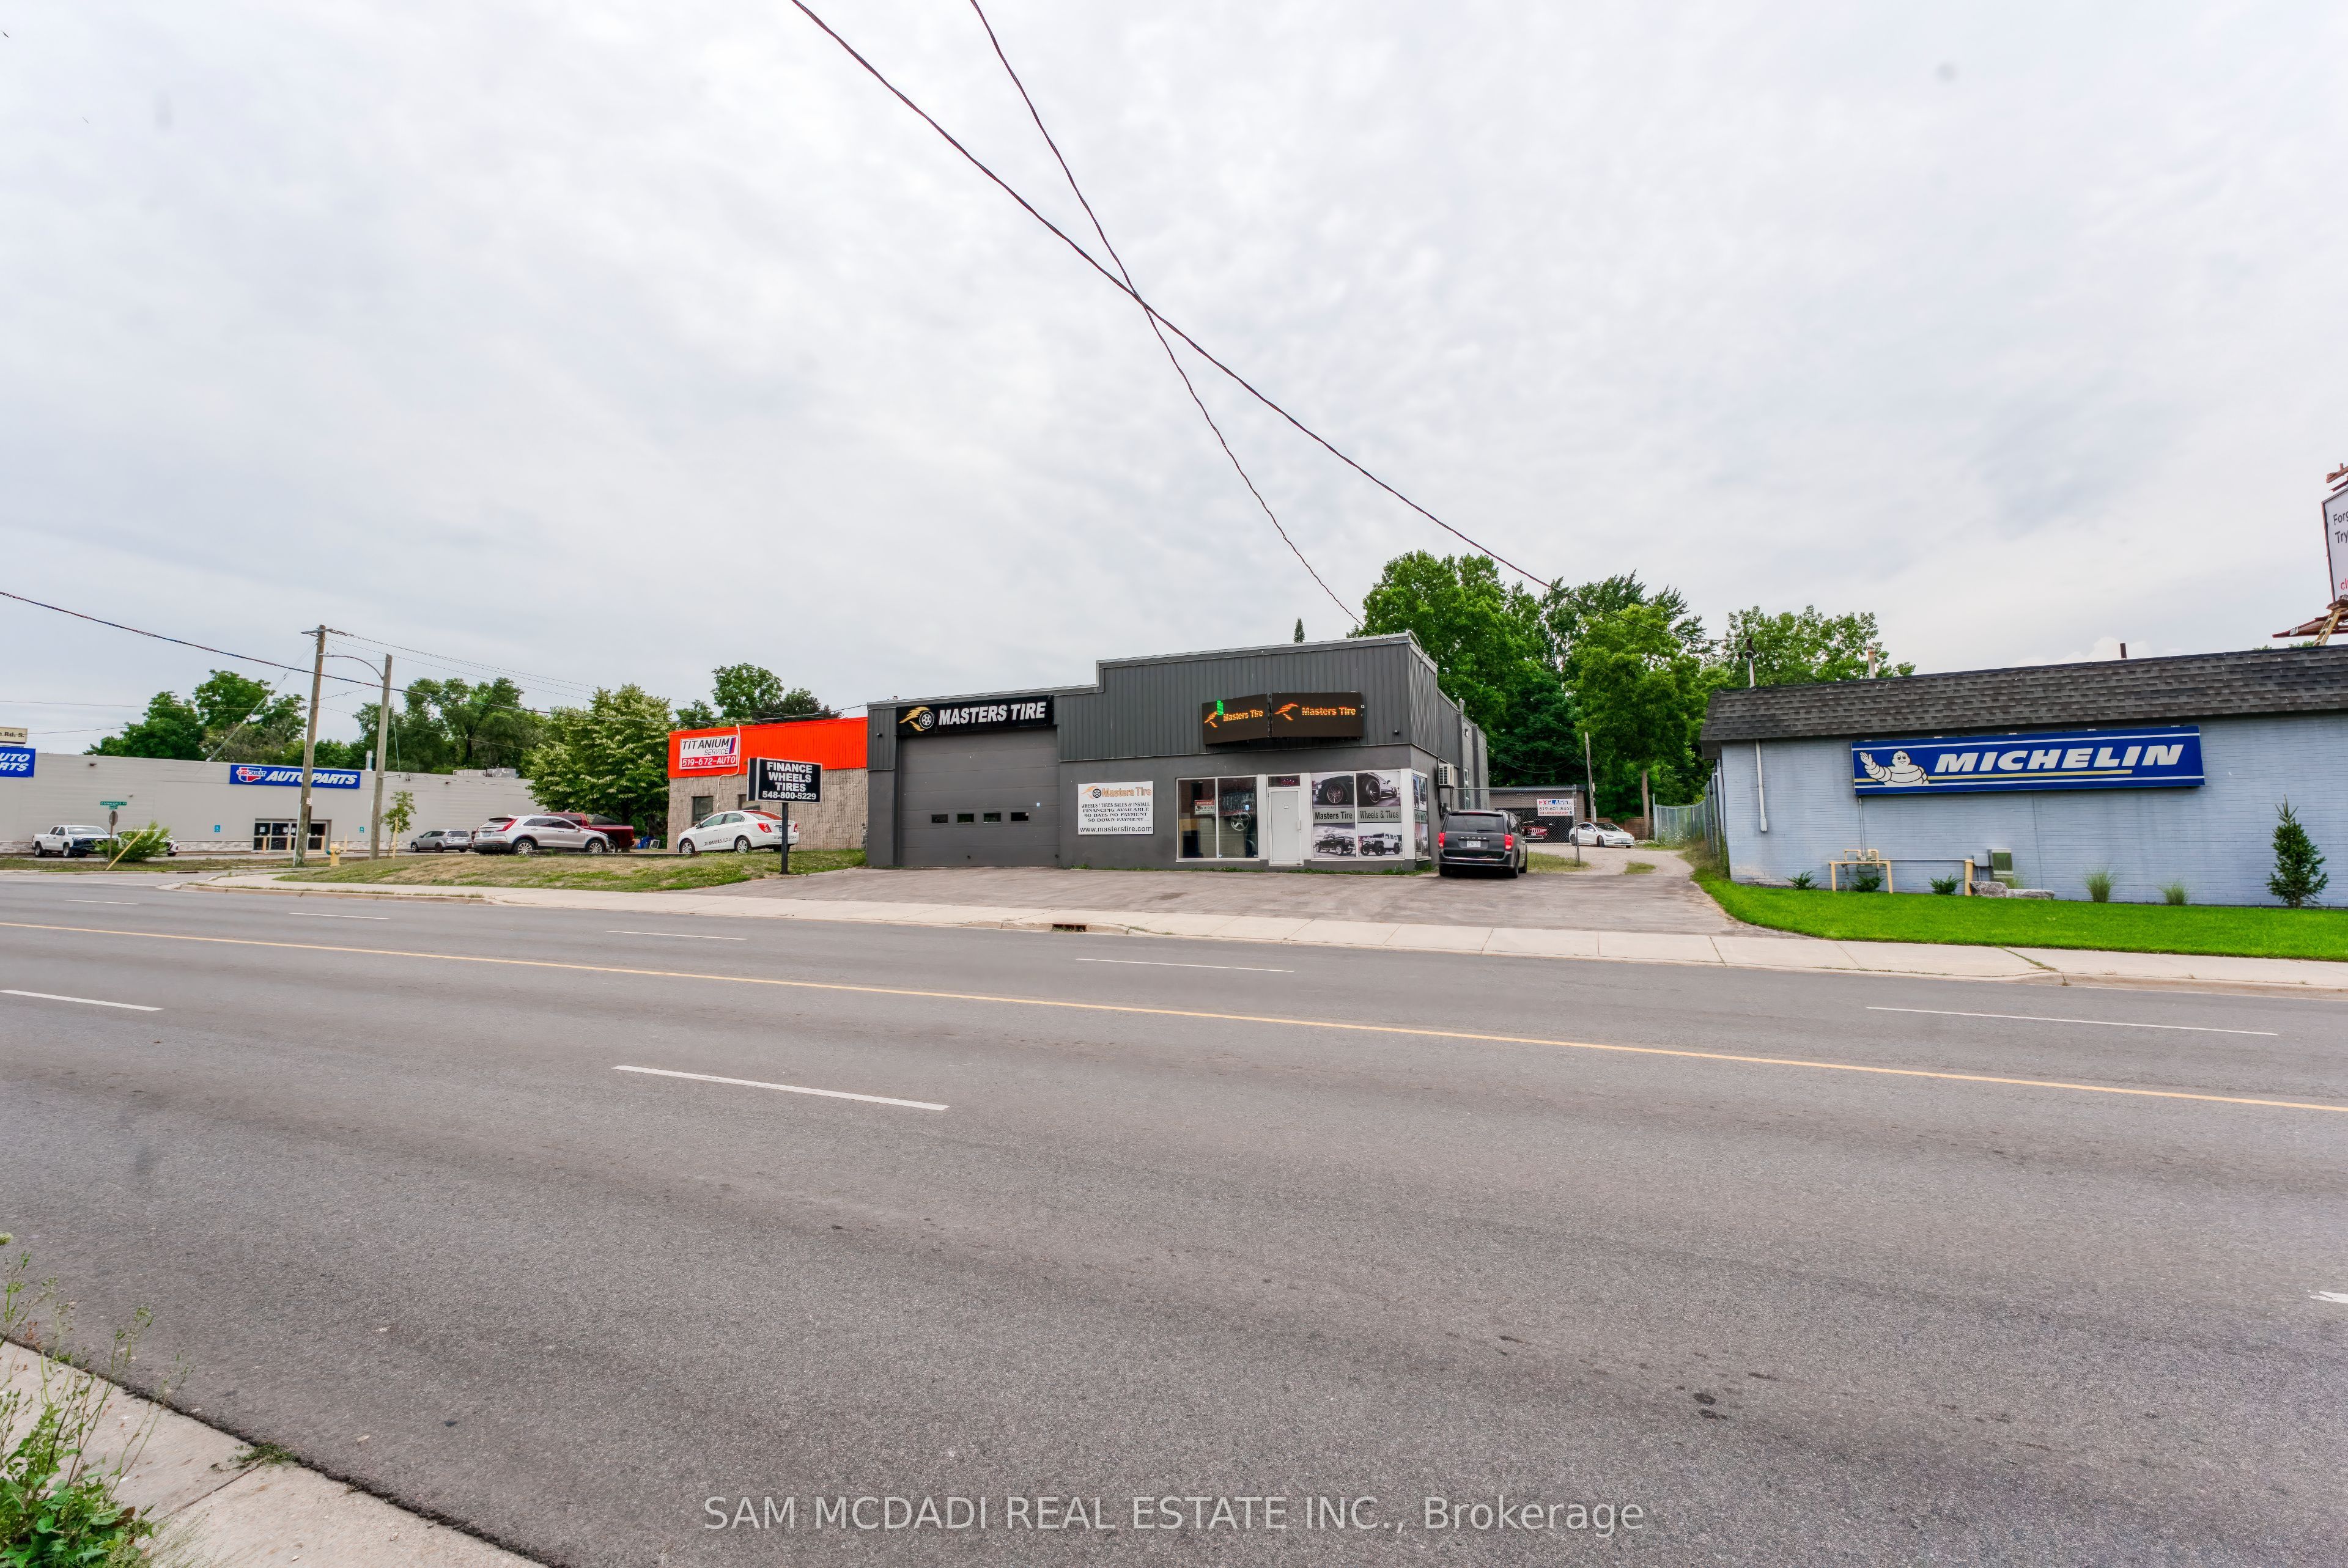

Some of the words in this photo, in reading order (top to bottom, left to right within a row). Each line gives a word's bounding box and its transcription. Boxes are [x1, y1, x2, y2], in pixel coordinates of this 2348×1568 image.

[939, 705, 1008, 726] MASTERS
[1011, 702, 1046, 720] TIRE
[682, 738, 730, 750] TITANIUM
[682, 756, 736, 767] 519-672-AUTO
[1935, 744, 2184, 773] MICHELIN
[767, 761, 813, 773] FINANCE
[311, 773, 358, 785] PARTS
[768, 771, 812, 783] WHEELS
[775, 782, 807, 792] TIRES
[1102, 788, 1135, 797] Masters
[1135, 787, 1152, 797] Tire
[762, 790, 817, 800] 548-800-5229
